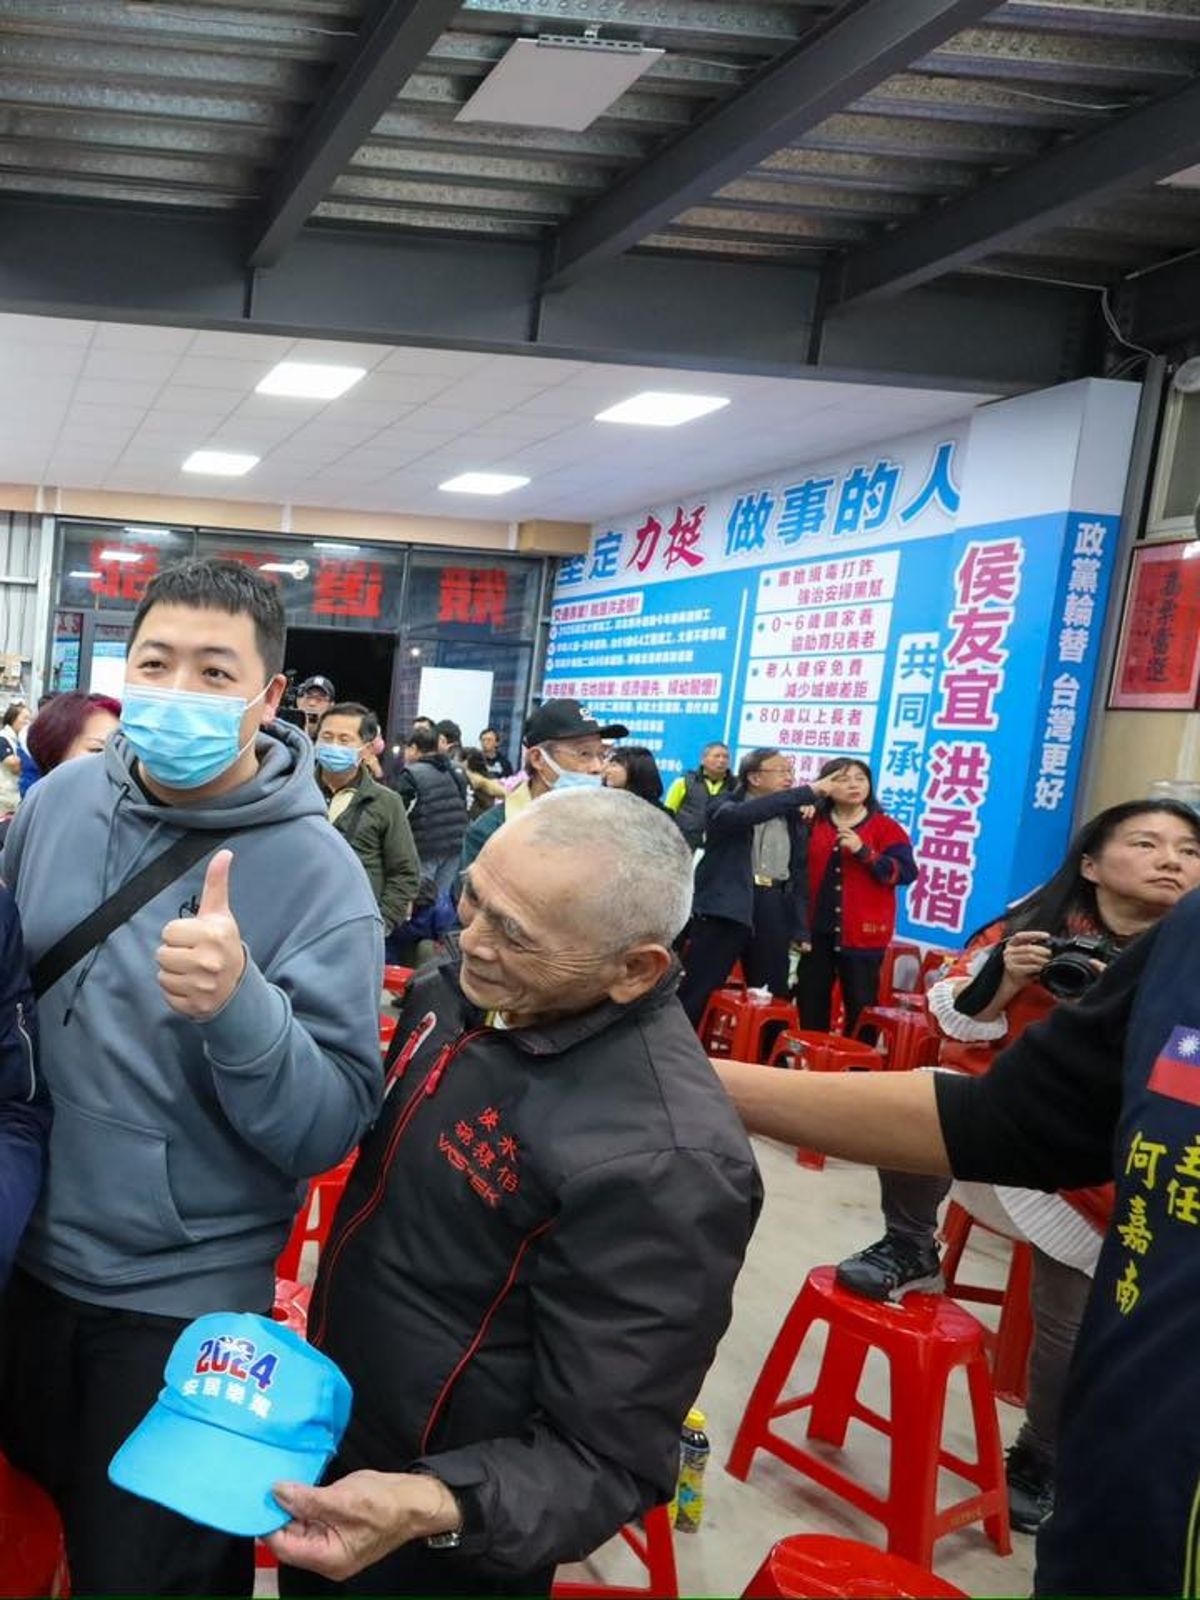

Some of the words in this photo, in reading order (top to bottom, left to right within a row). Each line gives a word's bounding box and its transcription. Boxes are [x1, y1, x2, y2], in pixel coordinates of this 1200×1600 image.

[725, 442, 961, 555] 做事的人
[937, 541, 1020, 727] 侯友宜
[1058, 522, 1107, 662] 政黨輪替
[759, 707, 862, 725] 80歲以上長者
[766, 658, 862, 678] 老人健保免費
[882, 642, 937, 828] 共同承諾
[1033, 673, 1081, 811] 台灣更好
[908, 745, 987, 929] 洪孟楷
[1115, 1130, 1168, 1316] 何嘉南
[195, 1336, 278, 1390] 2024
